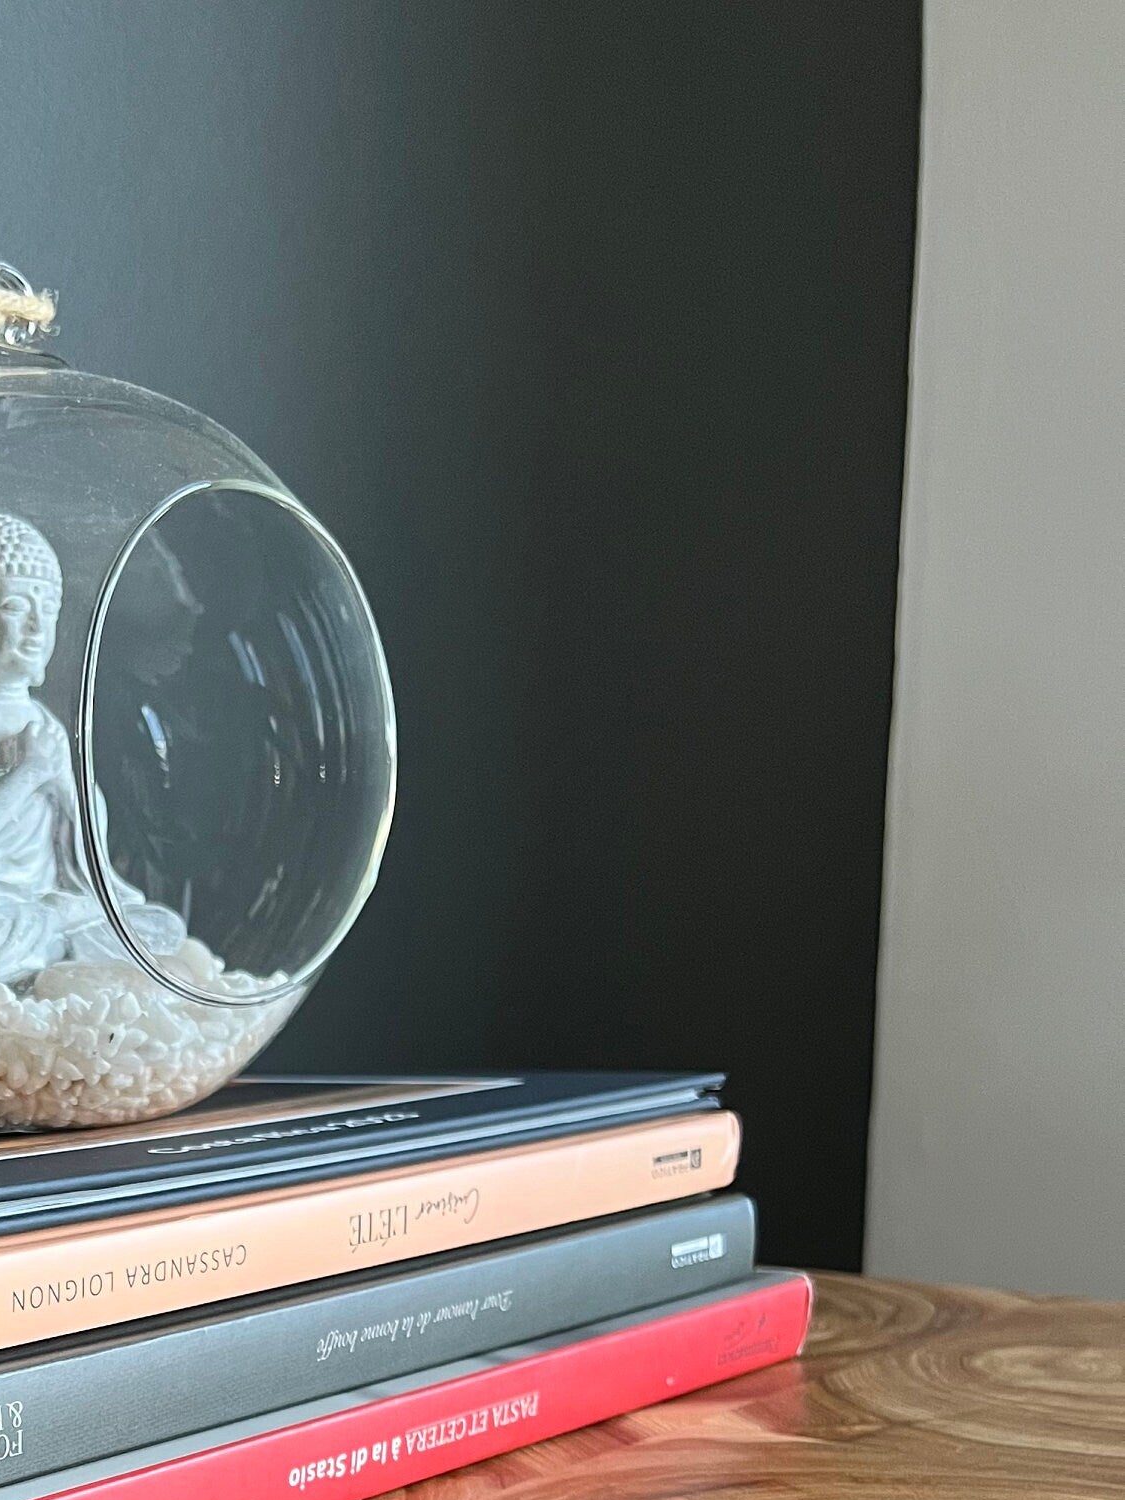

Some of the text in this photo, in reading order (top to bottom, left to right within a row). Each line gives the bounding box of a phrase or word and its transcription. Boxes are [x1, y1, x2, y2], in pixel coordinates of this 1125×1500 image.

[415, 1188, 480, 1225] Cuisiner
[12, 1245, 247, 1313] CASSANDRA LOIGNON
[361, 1319, 399, 1341] bonne
[402, 1316, 414, 1338] la
[416, 1311, 432, 1334] de
[316, 1328, 358, 1362] bouffe
[6, 1400, 23, 1428] &
[288, 1391, 539, 1491] PASTA ET CETERA à la di Stasio
